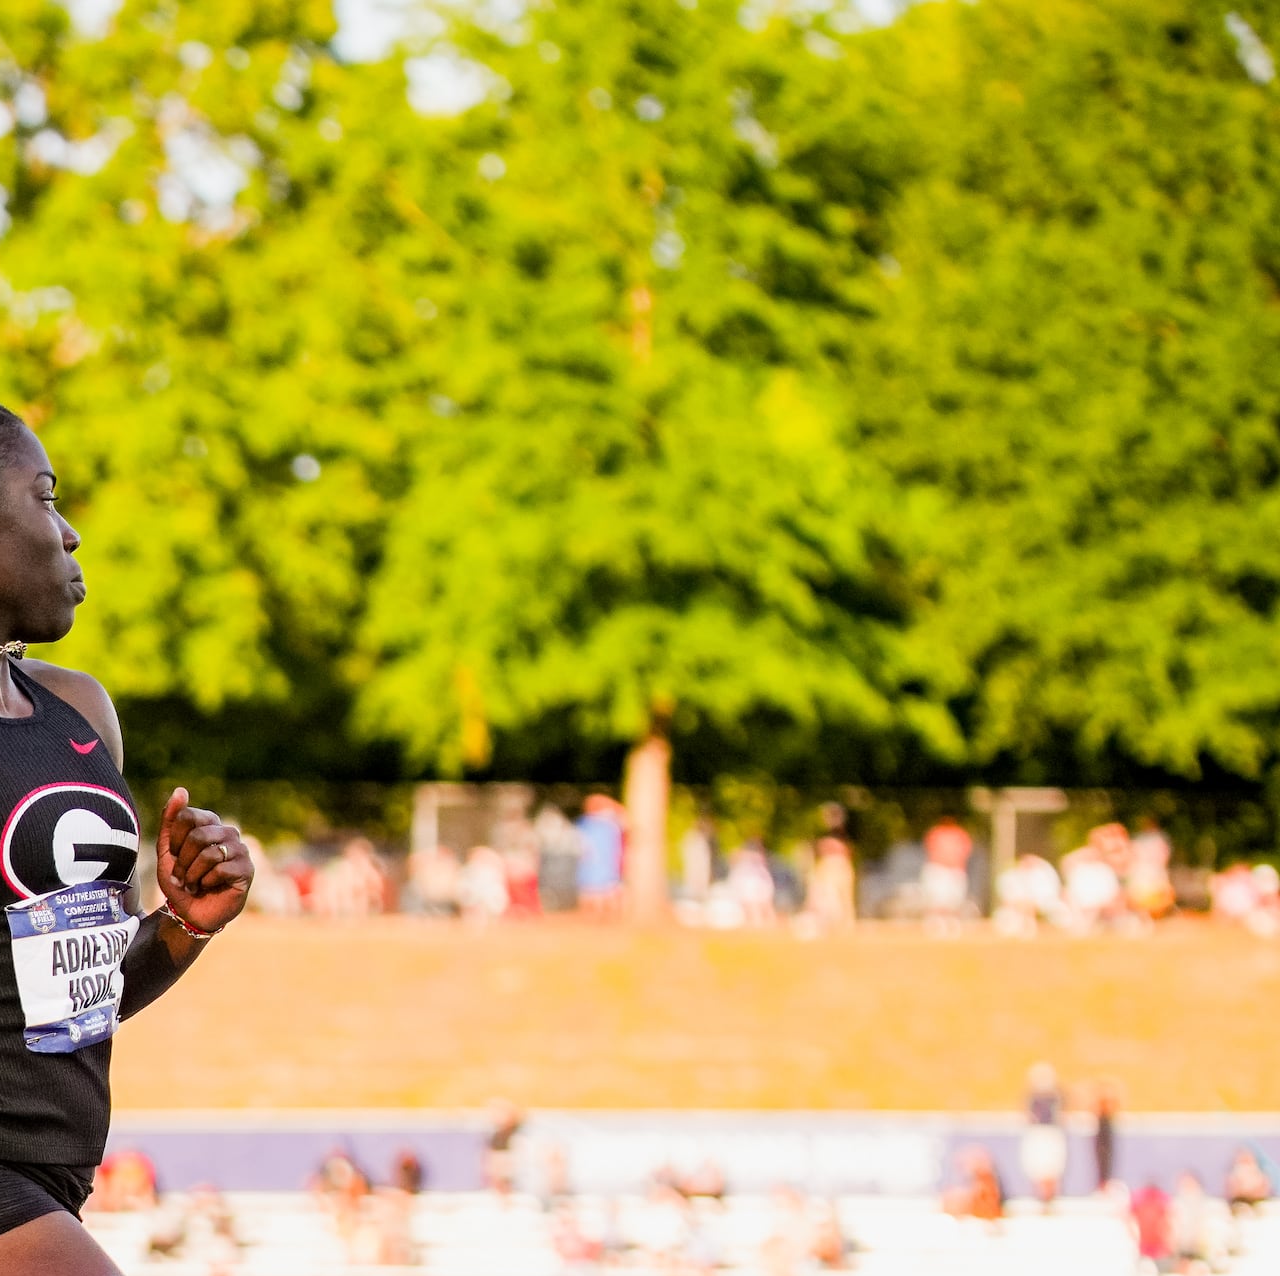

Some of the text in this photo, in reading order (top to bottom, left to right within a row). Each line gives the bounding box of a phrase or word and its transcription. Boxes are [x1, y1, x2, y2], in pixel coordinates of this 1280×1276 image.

[55, 888, 108, 904] SOUTHEASTERN
[64, 902, 108, 916] CONFERENCE
[52, 929, 129, 976] ADAEJAH
